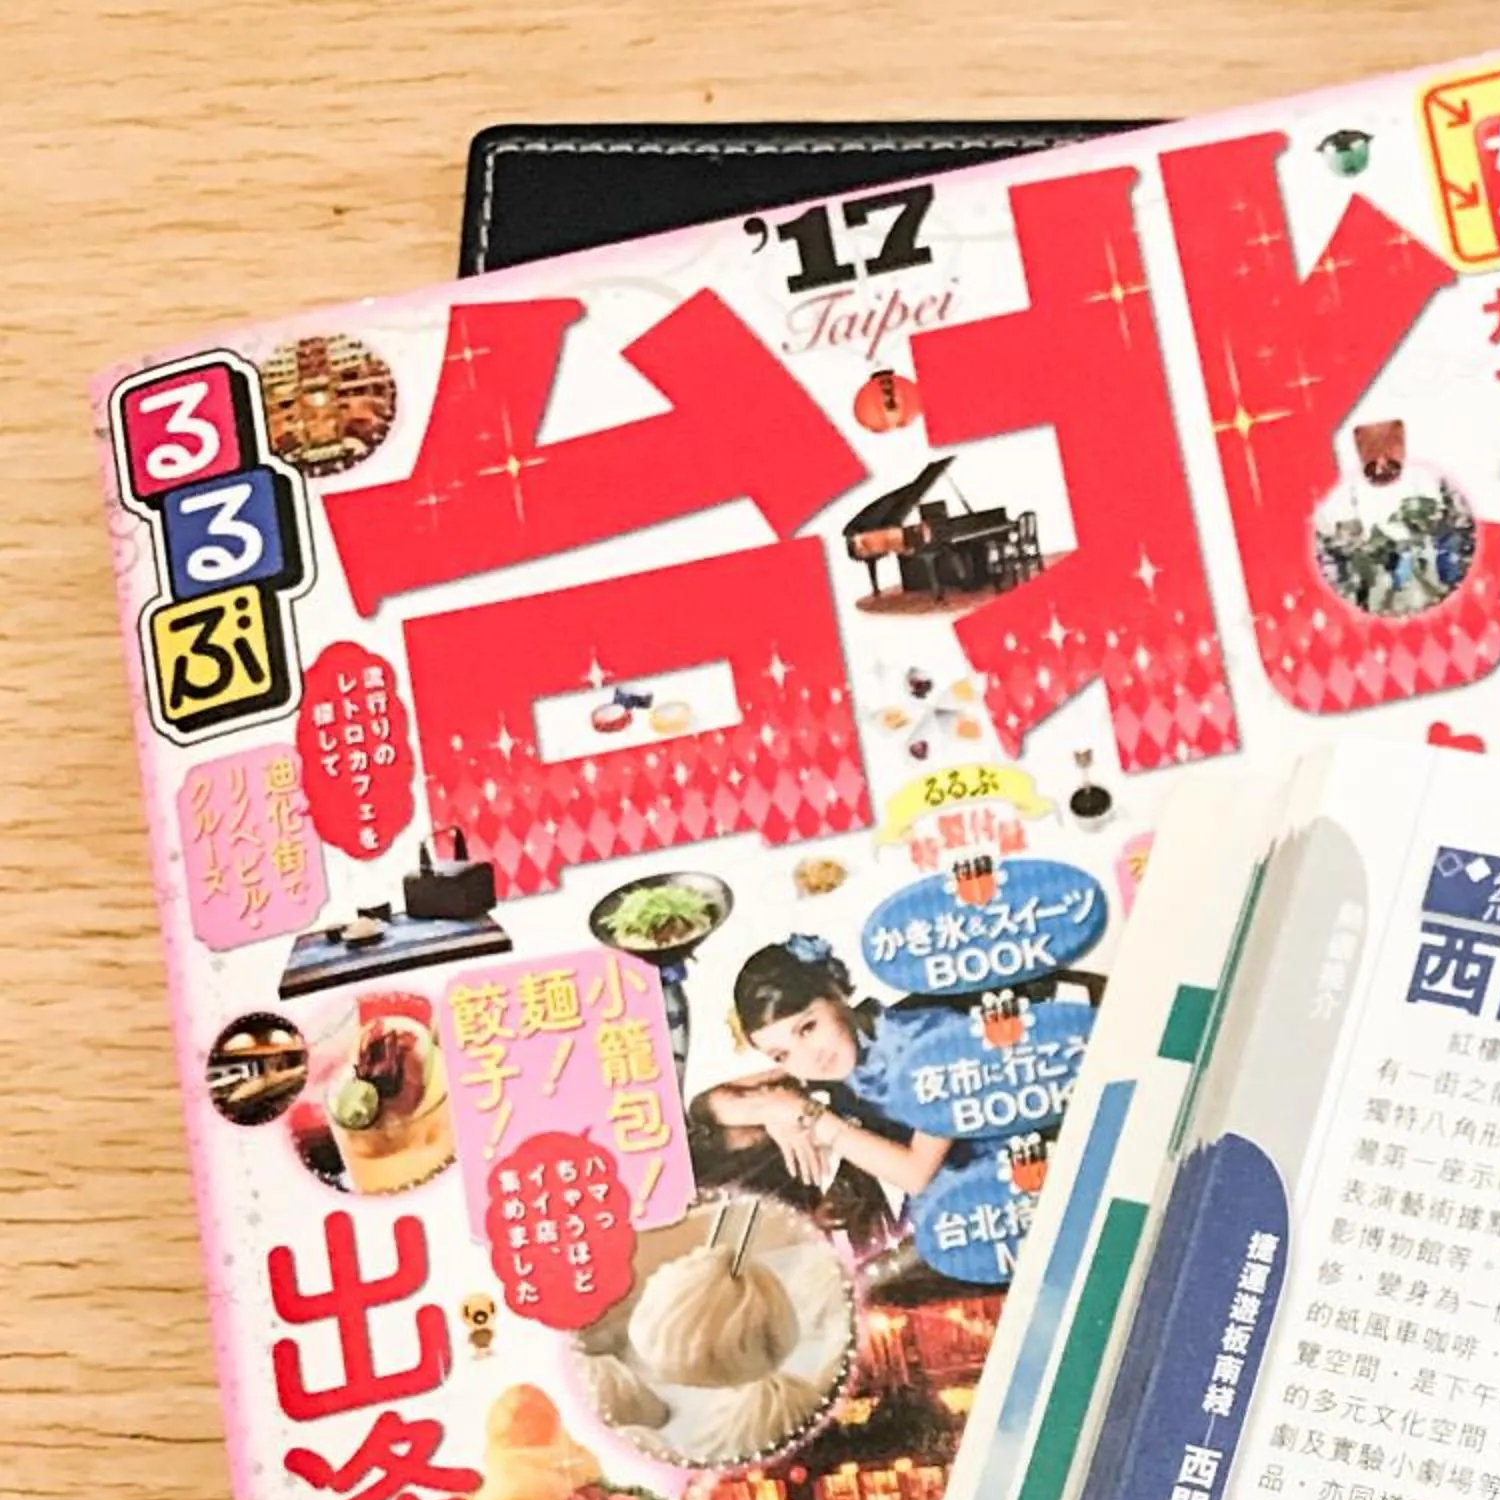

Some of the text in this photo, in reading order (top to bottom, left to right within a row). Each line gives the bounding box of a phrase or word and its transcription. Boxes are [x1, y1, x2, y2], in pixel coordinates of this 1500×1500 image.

[781, 276, 961, 354] Taipei
[138, 380, 266, 712] るるぶ
[336, 670, 380, 850] レトロカフェを
[924, 767, 1000, 805] るるぶ
[925, 934, 1056, 991] BOOK
[953, 1078, 1076, 1134] BOOK
